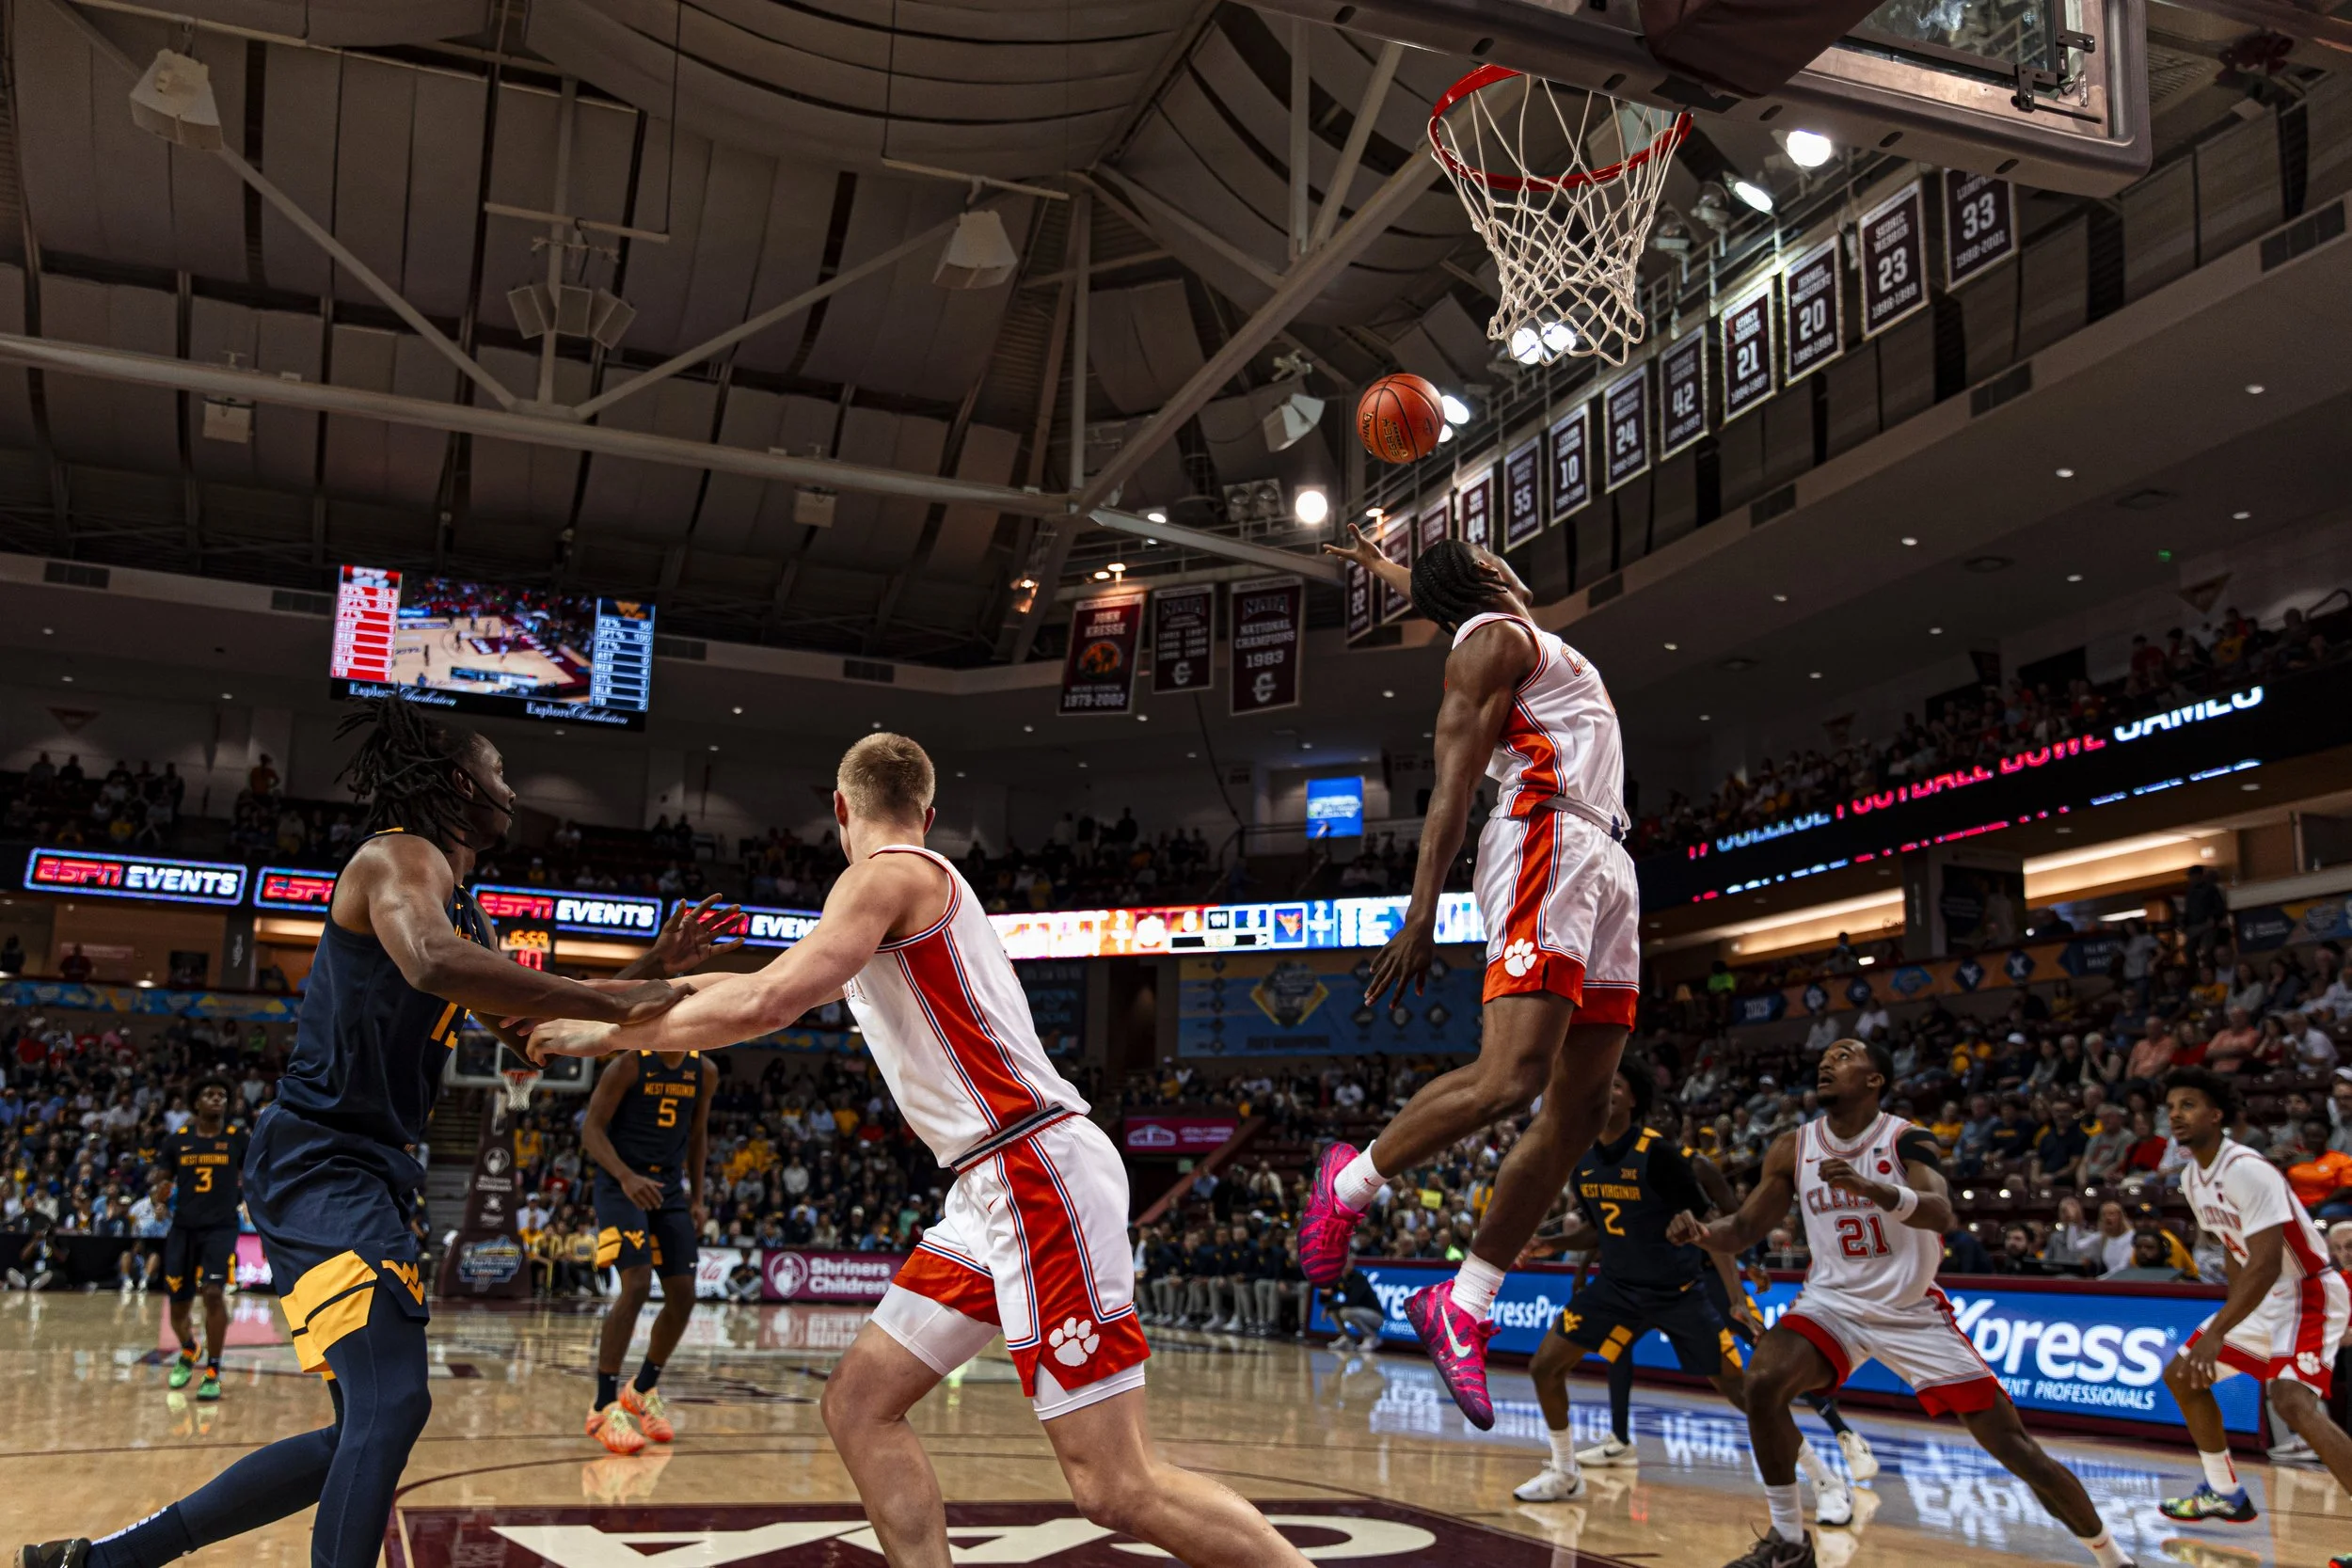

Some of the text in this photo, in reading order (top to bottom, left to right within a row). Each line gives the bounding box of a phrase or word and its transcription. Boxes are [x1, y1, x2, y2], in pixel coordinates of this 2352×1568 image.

[1963, 191, 1995, 240] 33
[1878, 246, 1908, 293] 23
[1799, 297, 1826, 342] 20
[1737, 340, 1759, 381] 21
[1672, 381, 1694, 418] 42
[1614, 418, 1637, 455] 24
[1560, 454, 1580, 490] 10
[1513, 483, 1533, 517] 55
[1246, 650, 1285, 669] 1983
[35, 857, 239, 895] ESPN EVENTS
[477, 894, 553, 920] ESPN
[555, 899, 656, 927] EVENTS
[751, 913, 820, 939] EVEN
[644, 1082, 696, 1099] WEST VIRGINIA
[658, 1098, 678, 1128] 5
[180, 1153, 230, 1166] WEST VIRGINIA
[195, 1166, 213, 1193] 3
[1599, 1183, 1642, 1201] VIRGINIA
[1806, 1186, 1875, 1216] CLEM
[1599, 1201, 1626, 1236] 2
[1835, 1212, 1892, 1261] 21
[808, 1257, 891, 1277] Shriners
[2034, 1379, 2155, 1411] PROFESSIONALS
